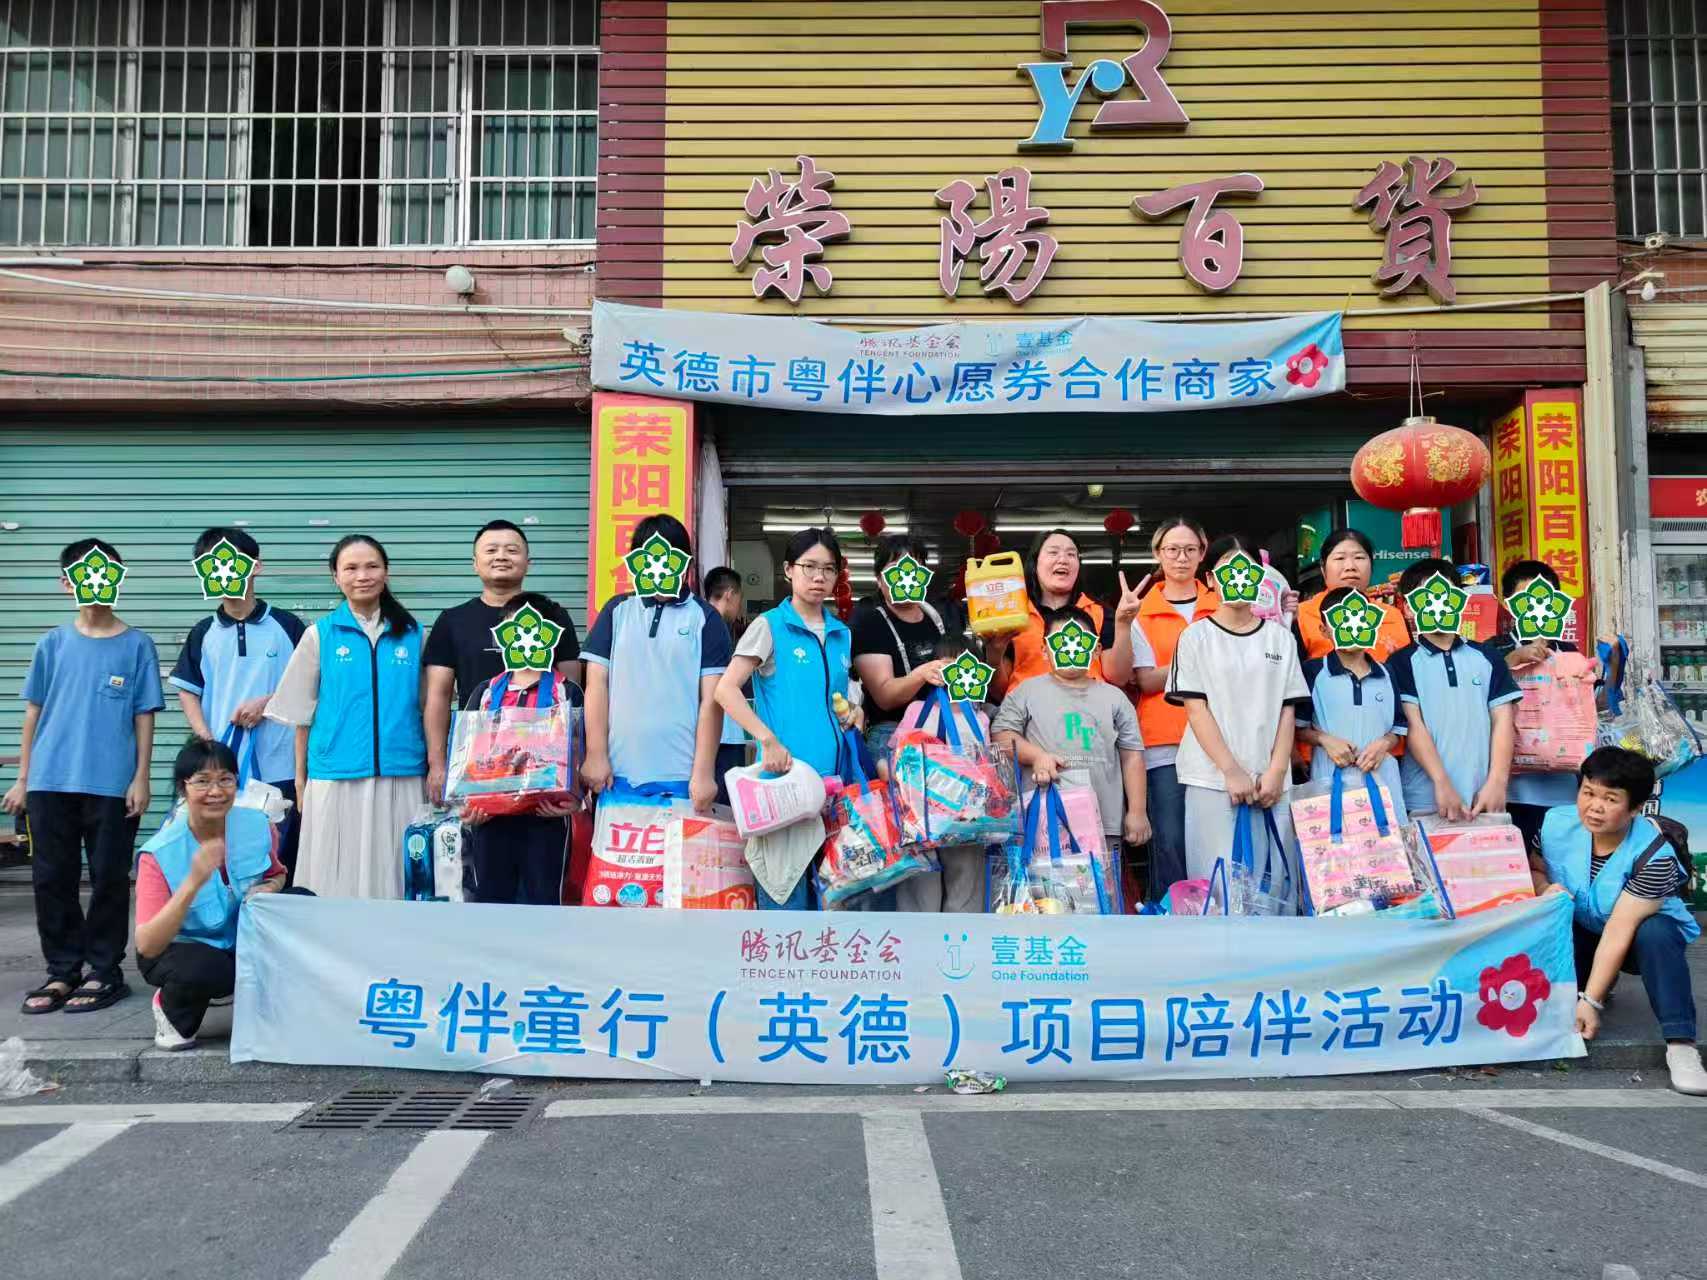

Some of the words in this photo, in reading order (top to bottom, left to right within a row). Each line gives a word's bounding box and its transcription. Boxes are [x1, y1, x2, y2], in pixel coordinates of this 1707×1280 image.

[731, 156, 1478, 304] 榮陽百貨
[618, 340, 1277, 404] 英德市粤伴心愿券合作商家
[1537, 413, 1579, 587] 荣阳百货
[1373, 550, 1430, 560] Hisense
[740, 927, 902, 964] 腾讯基金会
[991, 935, 1087, 967] 壹基金
[740, 968, 805, 980] TENCENT
[811, 968, 902, 981] FOUNDATION
[991, 971, 1016, 982] One
[1020, 971, 1089, 982] Foundation
